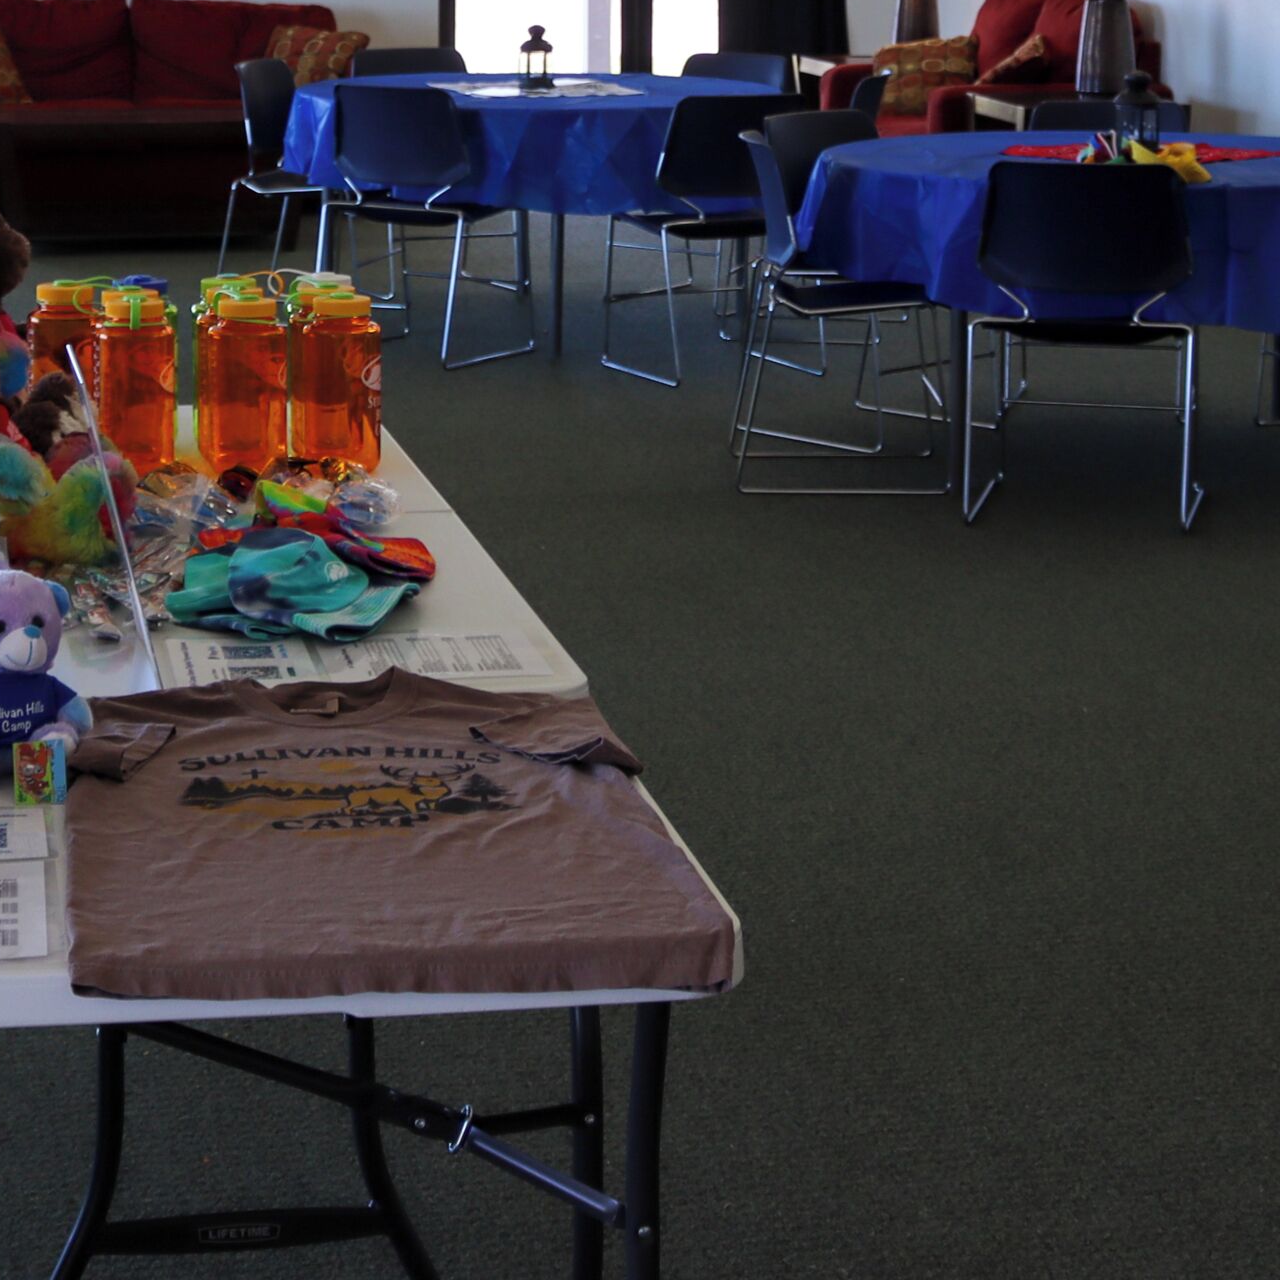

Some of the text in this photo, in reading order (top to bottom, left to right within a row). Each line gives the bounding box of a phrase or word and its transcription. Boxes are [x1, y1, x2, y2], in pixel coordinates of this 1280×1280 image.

[26, 700, 45, 715] Hills
[2, 720, 32, 734] Camp
[178, 745, 501, 771] SULLIVAN HILLS
[272, 814, 431, 831] CAMP
[207, 1226, 272, 1240] LIFETIME
